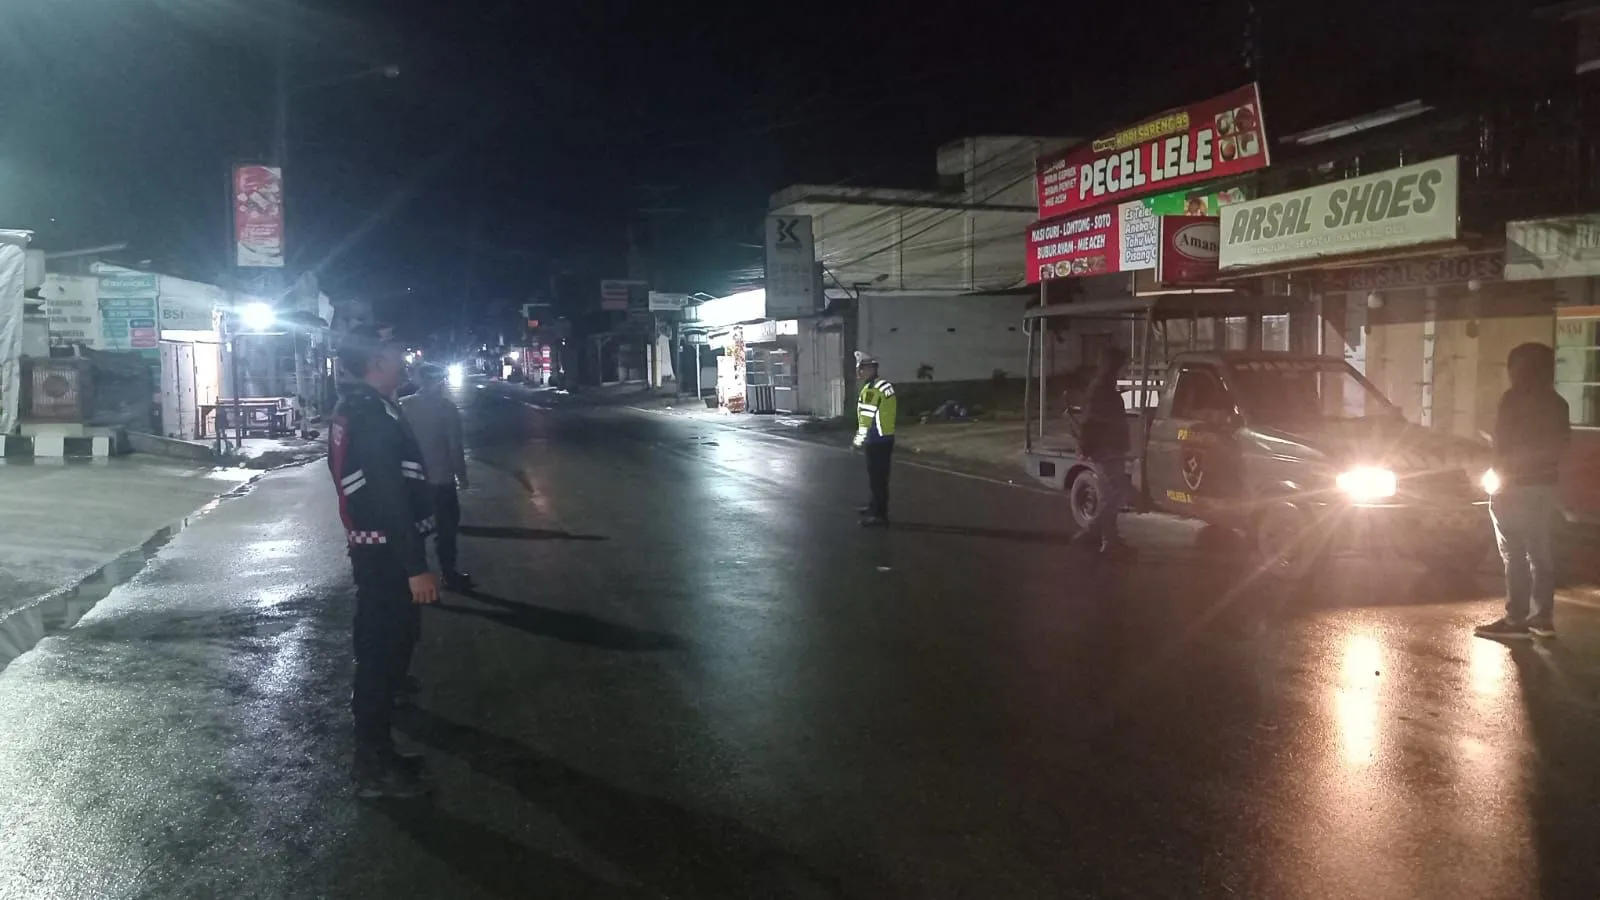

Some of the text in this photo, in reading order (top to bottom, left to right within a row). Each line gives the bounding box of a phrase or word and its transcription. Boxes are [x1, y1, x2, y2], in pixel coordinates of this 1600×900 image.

[1079, 128, 1213, 200] PECEL LELE
[1228, 168, 1442, 245] ARSAL SHOES
[1094, 213, 1111, 229] SOTO
[1037, 243, 1057, 259] BUBUR
[1077, 237, 1089, 252] MIE
[1089, 233, 1106, 249] ACEH
[1125, 235, 1143, 248] Tahu
[1125, 249, 1150, 264] Pisang
[163, 308, 184, 320] BSI
